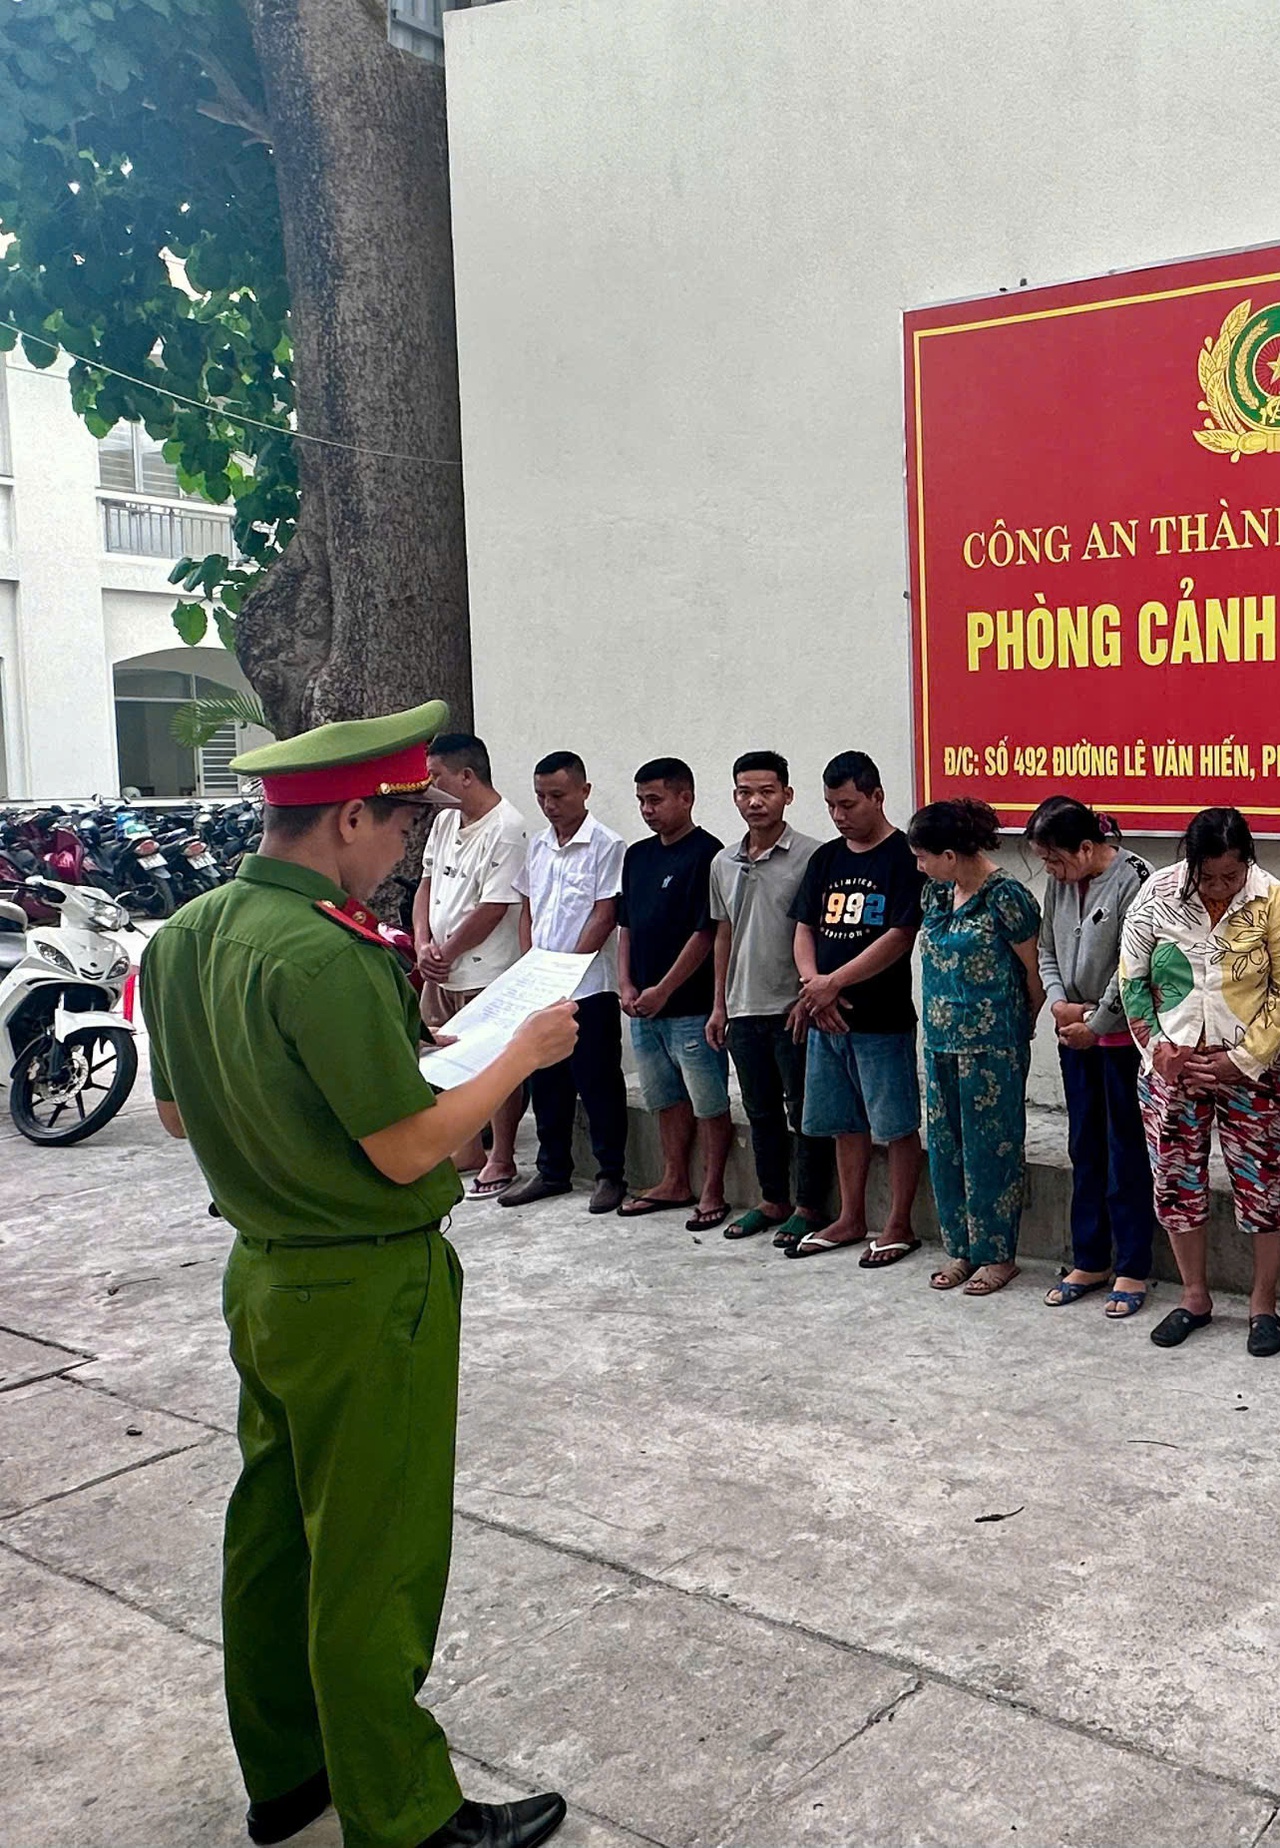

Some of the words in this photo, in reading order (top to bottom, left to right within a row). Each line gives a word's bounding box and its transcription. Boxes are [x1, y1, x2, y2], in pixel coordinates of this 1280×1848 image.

[963, 519, 1072, 569] CÔNG
[1081, 520, 1139, 560] AN
[967, 592, 1122, 672] PHÒNG
[1138, 577, 1277, 666] CẢNH
[944, 746, 980, 776] Đ/C:
[984, 735, 1010, 776] SỐ
[1013, 747, 1048, 776] 492
[1052, 738, 1118, 777] ĐƯỜNG
[1124, 738, 1147, 776] LÊ
[1152, 738, 1194, 776] VĂN
[1200, 734, 1256, 781] HIẾN,
[825, 892, 886, 926] 992
